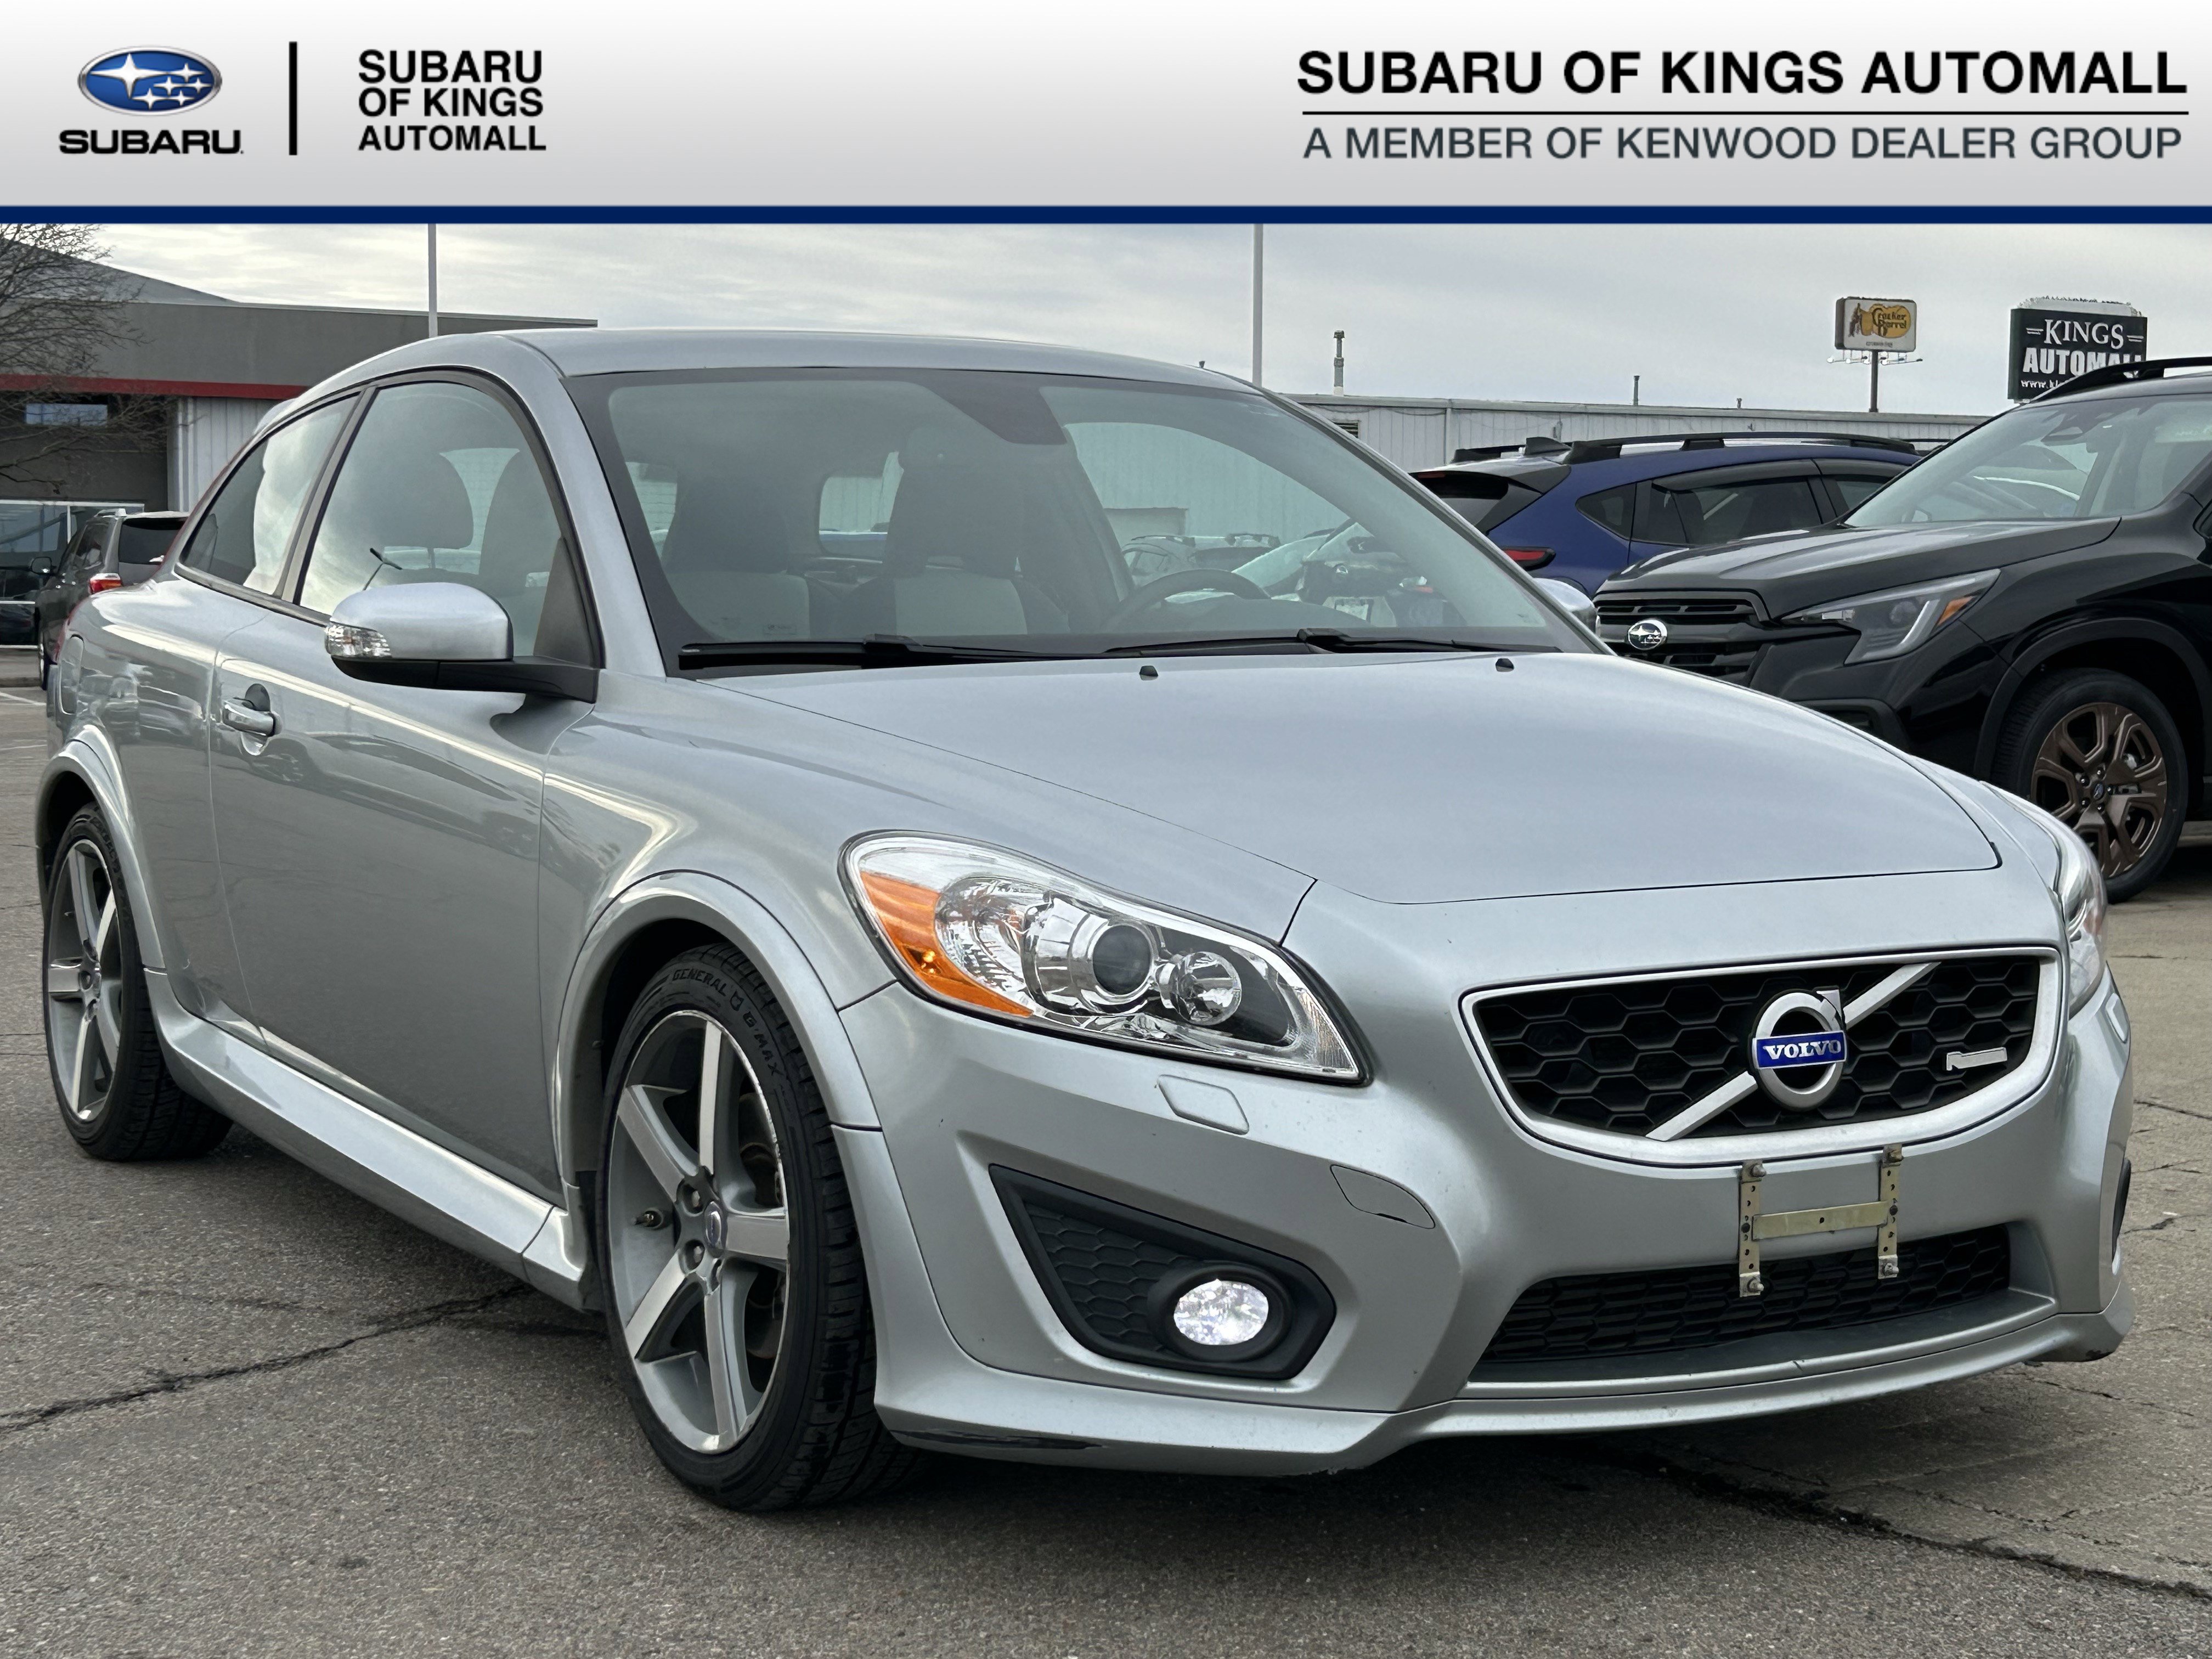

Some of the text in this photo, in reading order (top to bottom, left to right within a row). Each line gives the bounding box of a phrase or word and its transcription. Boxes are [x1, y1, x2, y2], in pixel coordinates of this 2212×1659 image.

[2044, 319, 2124, 349] KINGS
[673, 968, 727, 996] GENERAL
[1762, 1039, 1842, 1060] VOLVO
